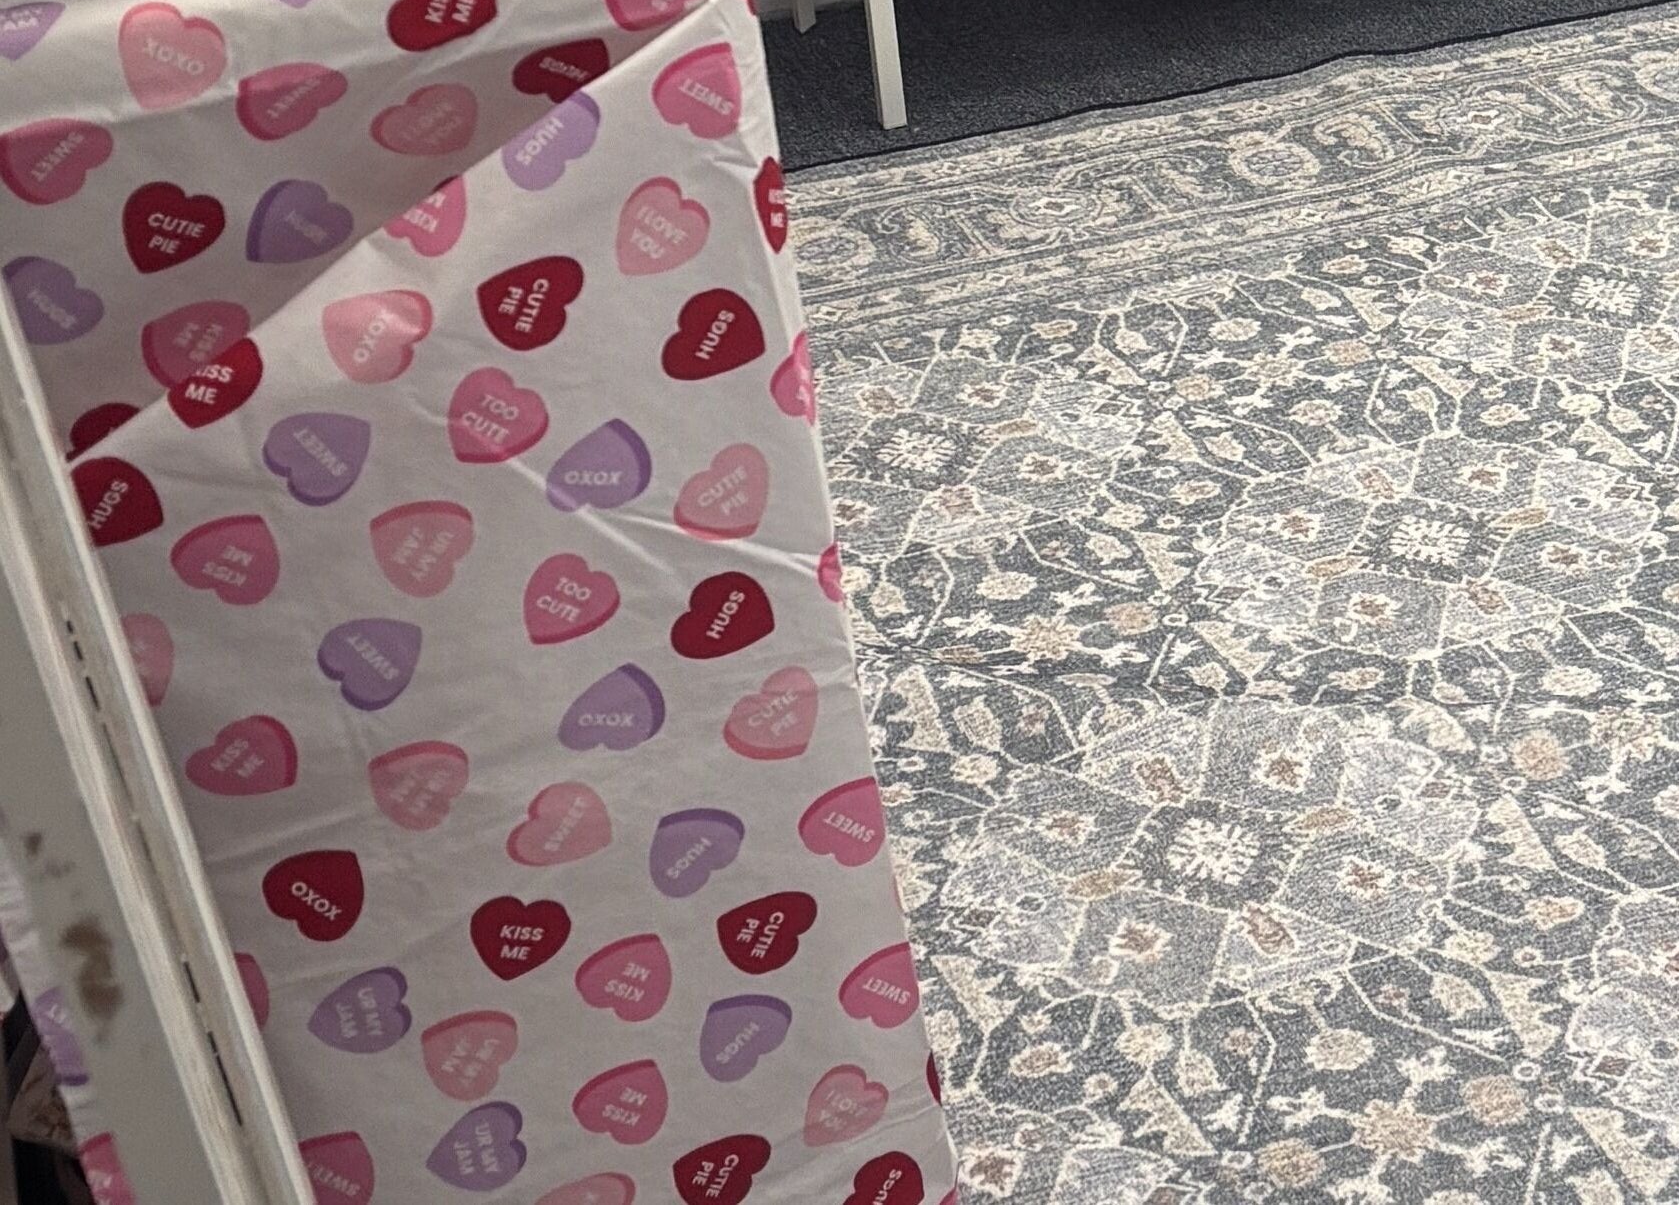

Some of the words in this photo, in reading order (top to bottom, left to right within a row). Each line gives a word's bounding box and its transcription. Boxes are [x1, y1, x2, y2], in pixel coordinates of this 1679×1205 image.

[142, 38, 206, 76] XOXO
[678, 77, 735, 117] SWEET
[515, 117, 564, 167] HUGS
[148, 212, 205, 239] CUTIE
[148, 237, 180, 255] PIE
[498, 285, 525, 315] PIE
[514, 277, 551, 334] CUTIE
[695, 309, 736, 362] HUGS
[184, 383, 218, 405] ME
[480, 394, 520, 421] TOO
[461, 411, 512, 443] CUTE
[292, 428, 350, 478] SWEET
[696, 465, 750, 507] CUTIE
[90, 479, 129, 530] HUGS
[720, 491, 750, 517] PIE
[223, 545, 255, 567] ME
[202, 561, 248, 588] KISS
[554, 576, 592, 601] TOO
[535, 595, 583, 623] CUTE
[706, 589, 746, 640] HUGS
[346, 632, 400, 682] SWEET
[747, 691, 800, 729] CUTIE
[769, 712, 800, 738] PIE
[211, 737, 250, 772] KISS
[542, 796, 586, 853] SWEET
[822, 811, 876, 845] SWEET
[665, 836, 713, 881] HUGS
[499, 925, 545, 941] KISS
[735, 916, 761, 944] PIE
[750, 910, 786, 960] CUTIE
[500, 945, 532, 961] ME
[621, 962, 652, 983] ME
[604, 979, 646, 1003] KISS
[861, 976, 912, 1004] SWEET
[714, 1021, 761, 1066] HUGS
[619, 1086, 649, 1106] ME
[602, 1103, 642, 1127] KISS
[691, 1159, 715, 1187] PIE
[705, 1153, 740, 1199] CUTIE
